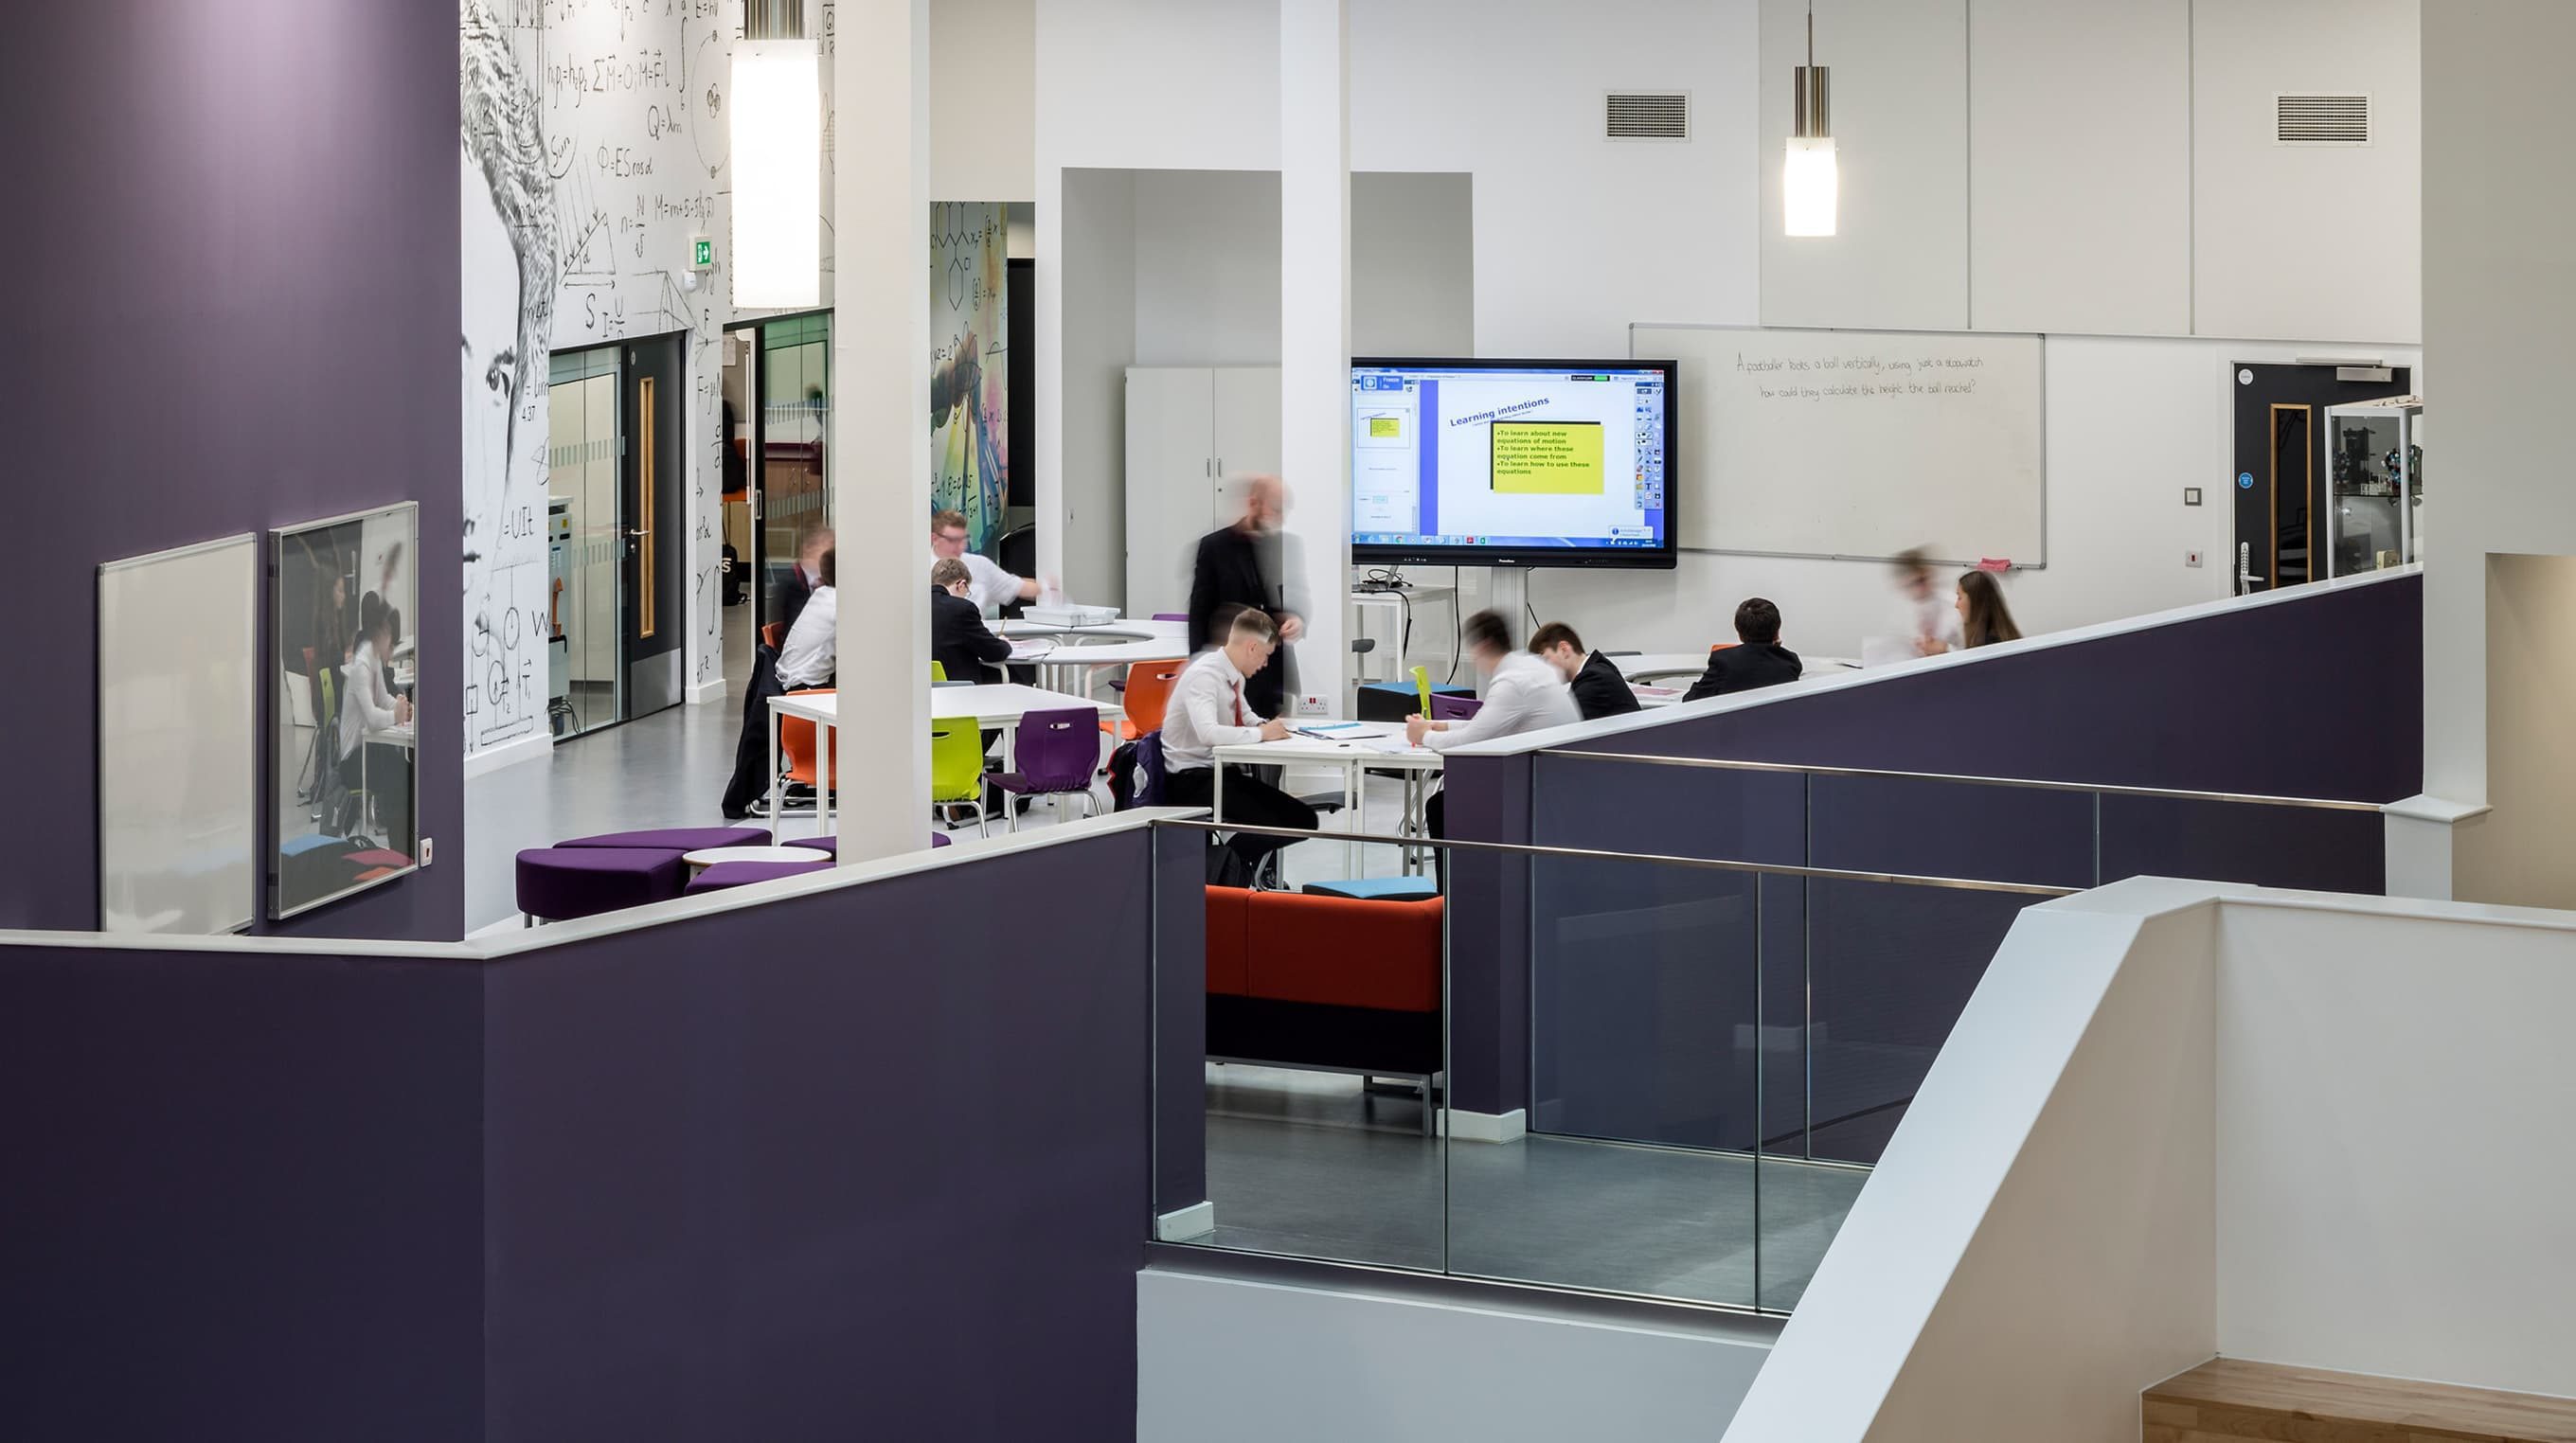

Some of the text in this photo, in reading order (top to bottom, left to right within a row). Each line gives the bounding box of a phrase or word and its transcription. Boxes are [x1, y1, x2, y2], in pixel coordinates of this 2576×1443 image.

[550, 134, 570, 169] Sun
[1736, 351, 1744, 371] A
[1823, 356, 1839, 369] ball
[1888, 361, 1911, 376] using
[1779, 385, 1798, 398] could
[1801, 385, 1819, 402] they
[1822, 383, 1857, 396] calculate
[1908, 382, 1924, 394] the
[1450, 410, 1495, 427] Learning
[1497, 397, 1550, 416] intentions
